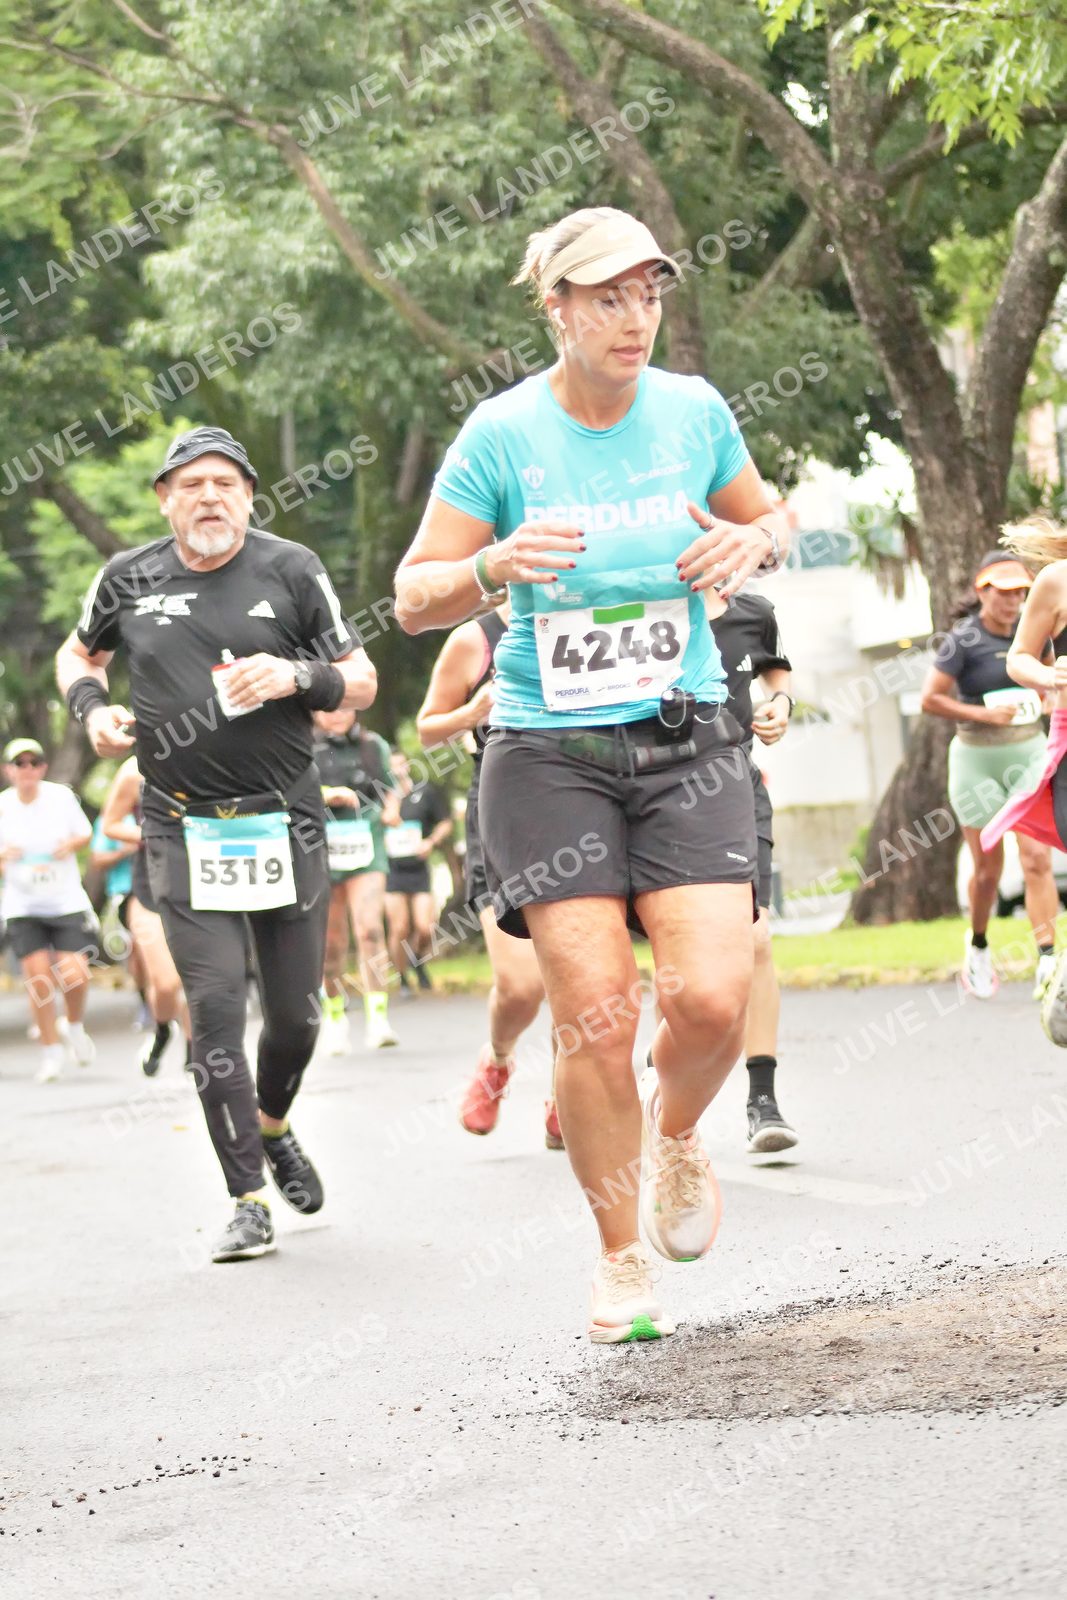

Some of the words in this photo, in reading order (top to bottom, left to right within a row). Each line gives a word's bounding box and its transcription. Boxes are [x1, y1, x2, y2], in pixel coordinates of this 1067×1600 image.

[551, 620, 681, 674] 4248
[555, 687, 590, 697] PERDURA
[200, 857, 284, 886] 5319
